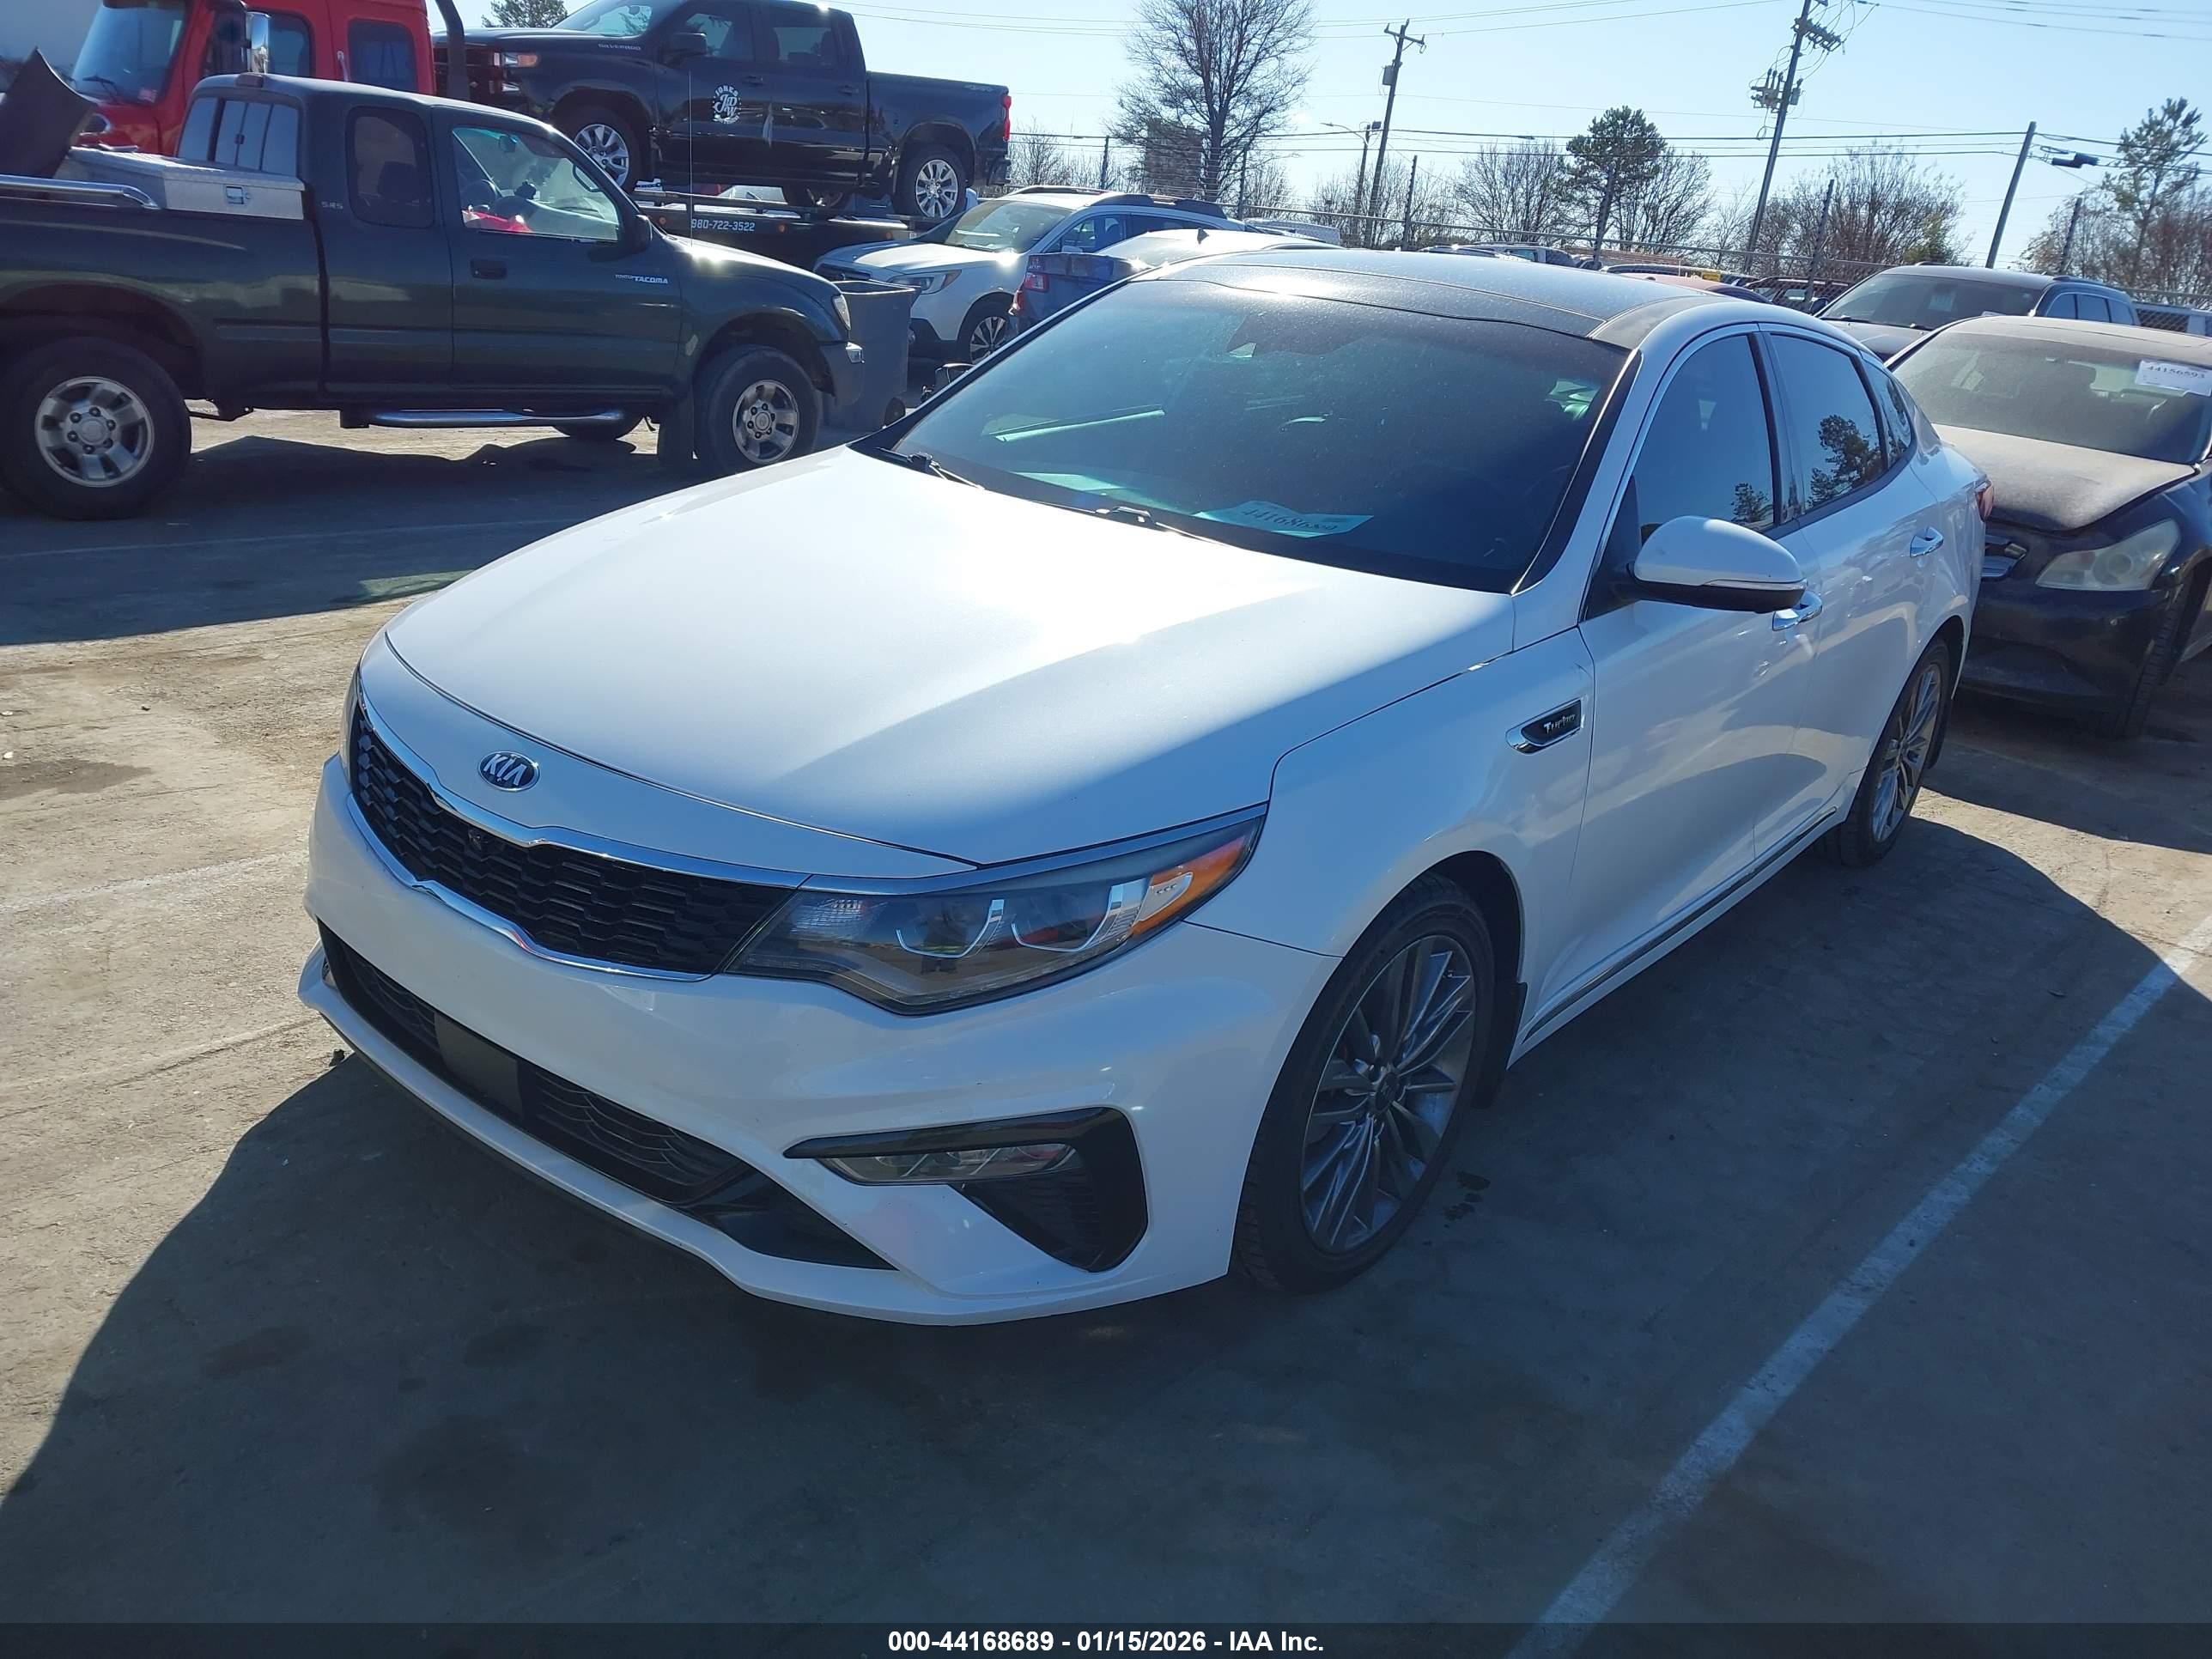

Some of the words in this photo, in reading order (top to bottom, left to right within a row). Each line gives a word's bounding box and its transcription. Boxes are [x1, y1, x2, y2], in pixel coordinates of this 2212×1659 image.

[690, 218, 756, 232] 980-722-3522
[634, 276, 668, 284] TACOMA
[483, 754, 527, 786] KIA
